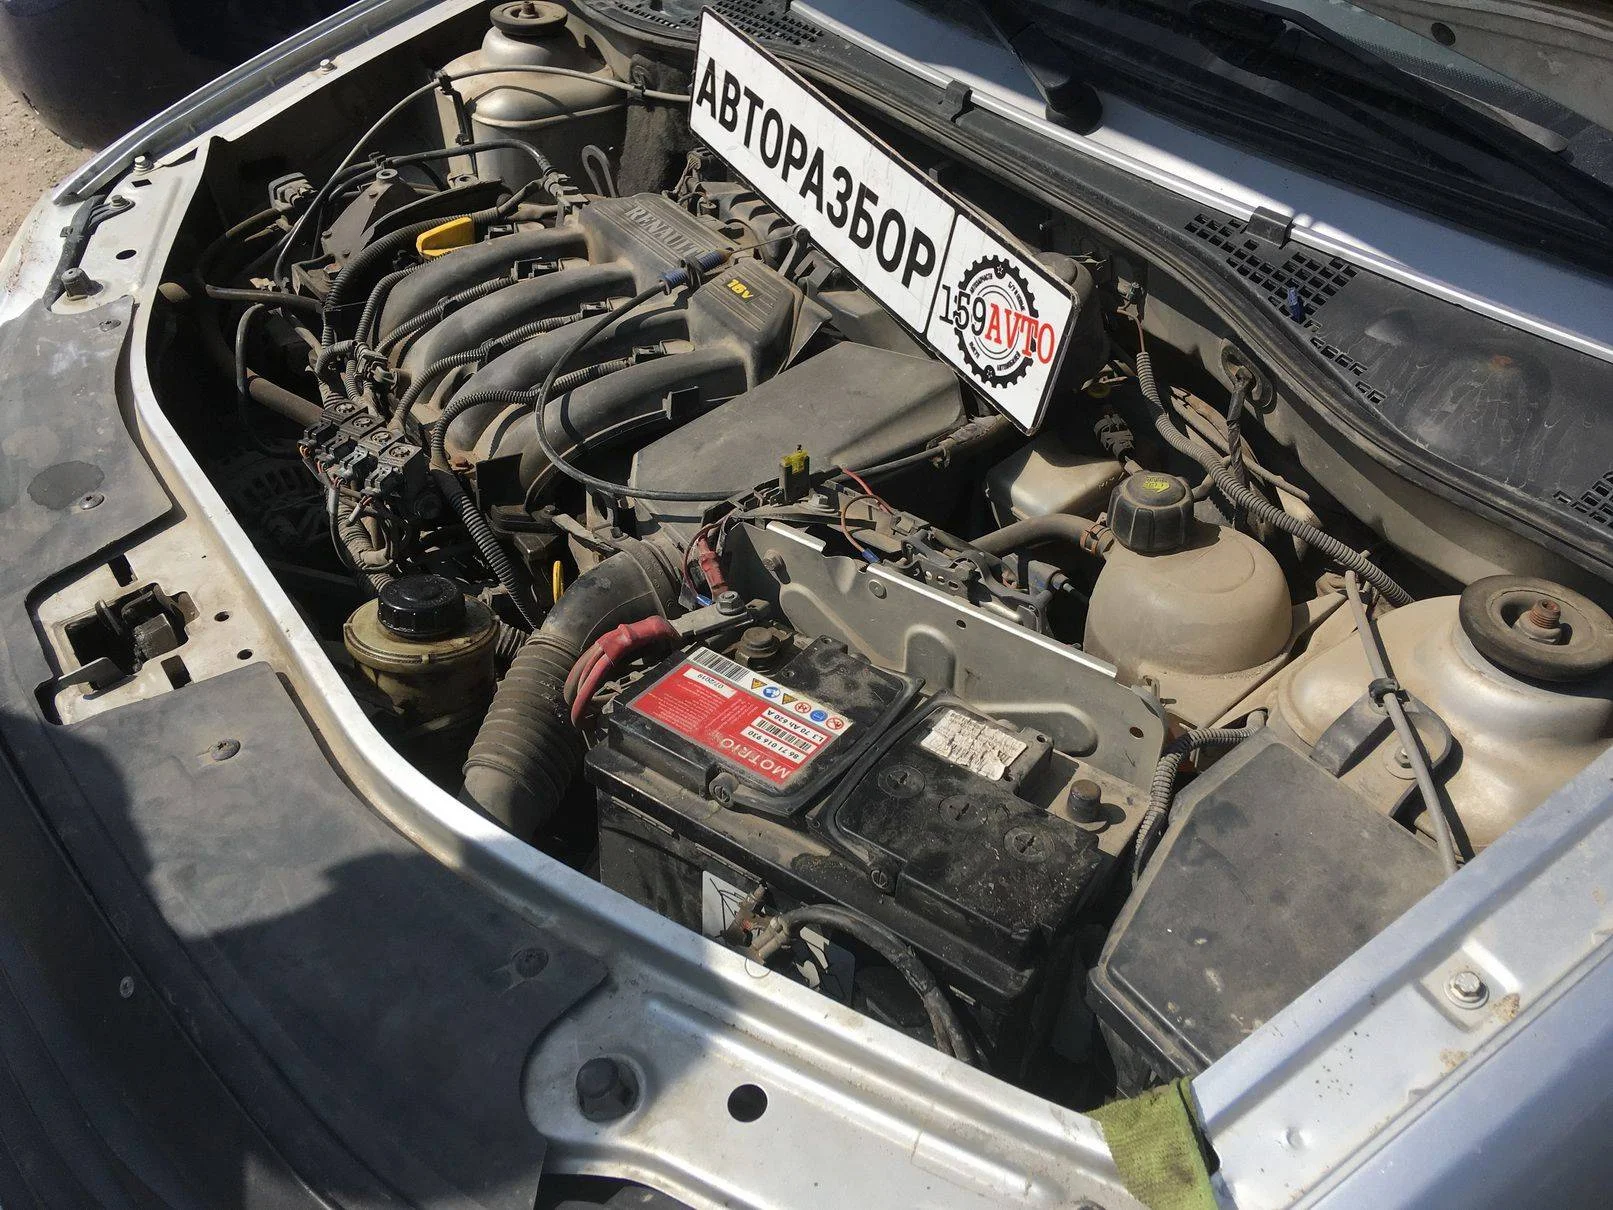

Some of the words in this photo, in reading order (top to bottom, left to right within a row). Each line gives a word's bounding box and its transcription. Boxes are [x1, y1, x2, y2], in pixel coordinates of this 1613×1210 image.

[696, 57, 936, 290] АВТОРАЗБОР
[624, 206, 705, 258] RENAULT
[774, 713, 788, 725] 620
[789, 721, 800, 730] Ah
[747, 730, 762, 741] 930
[800, 728, 811, 736] 70
[778, 744, 788, 754] 71
[720, 738, 791, 779] MOTRIO
